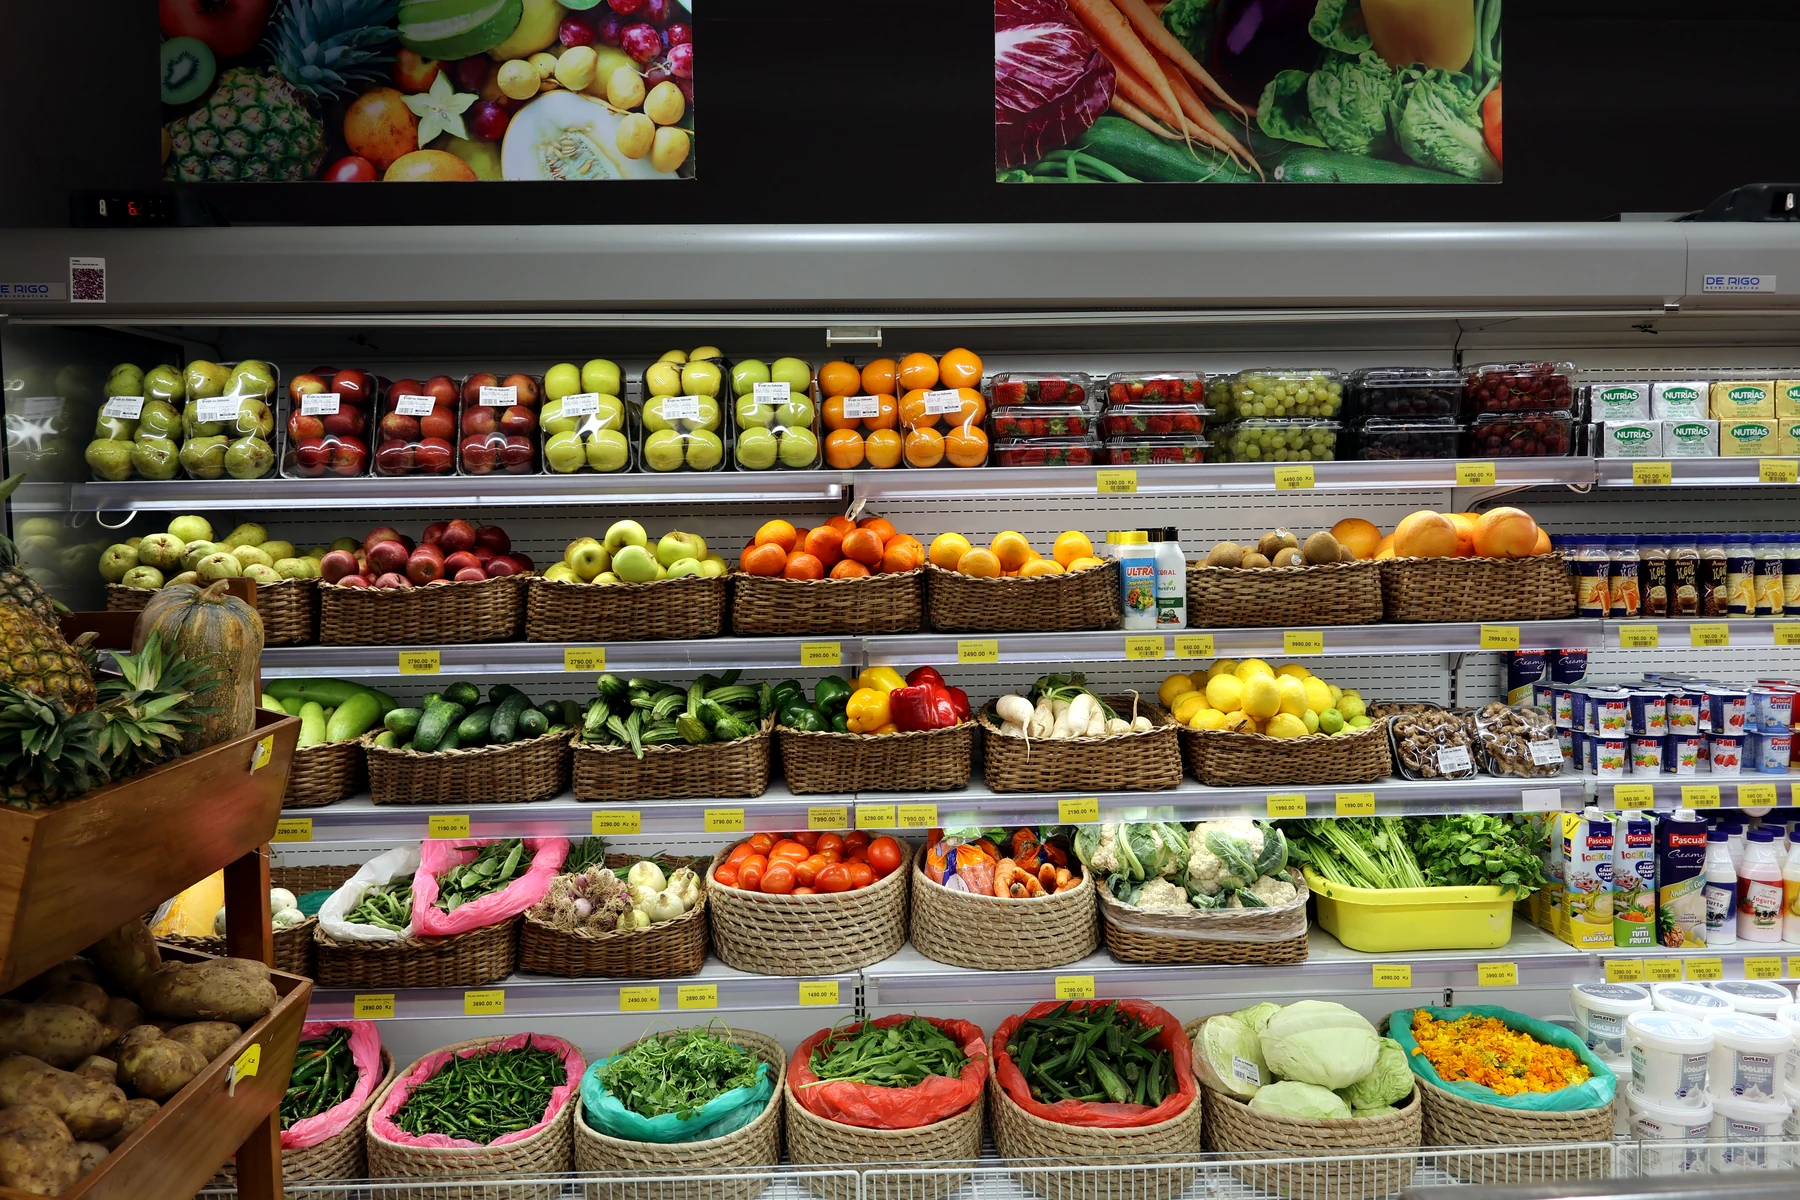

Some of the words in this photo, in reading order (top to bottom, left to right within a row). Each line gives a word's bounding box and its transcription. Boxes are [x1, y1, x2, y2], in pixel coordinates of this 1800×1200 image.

[1706, 277, 1724, 285] DE
[1728, 277, 1760, 285] RIGO
[1, 285, 10, 293] E
[14, 285, 48, 293] RIGO
[1127, 567, 1154, 576] ULTRA
[1513, 658, 1545, 670] Creamy
[1559, 657, 1587, 668] Creamy
[1672, 698, 1692, 706] PMI
[1637, 739, 1657, 747] PMI
[1716, 738, 1737, 747] PMI
[1672, 836, 1705, 844] Pascual
[1668, 849, 1706, 864] Creamy
[1752, 896, 1776, 906] Iogurte
